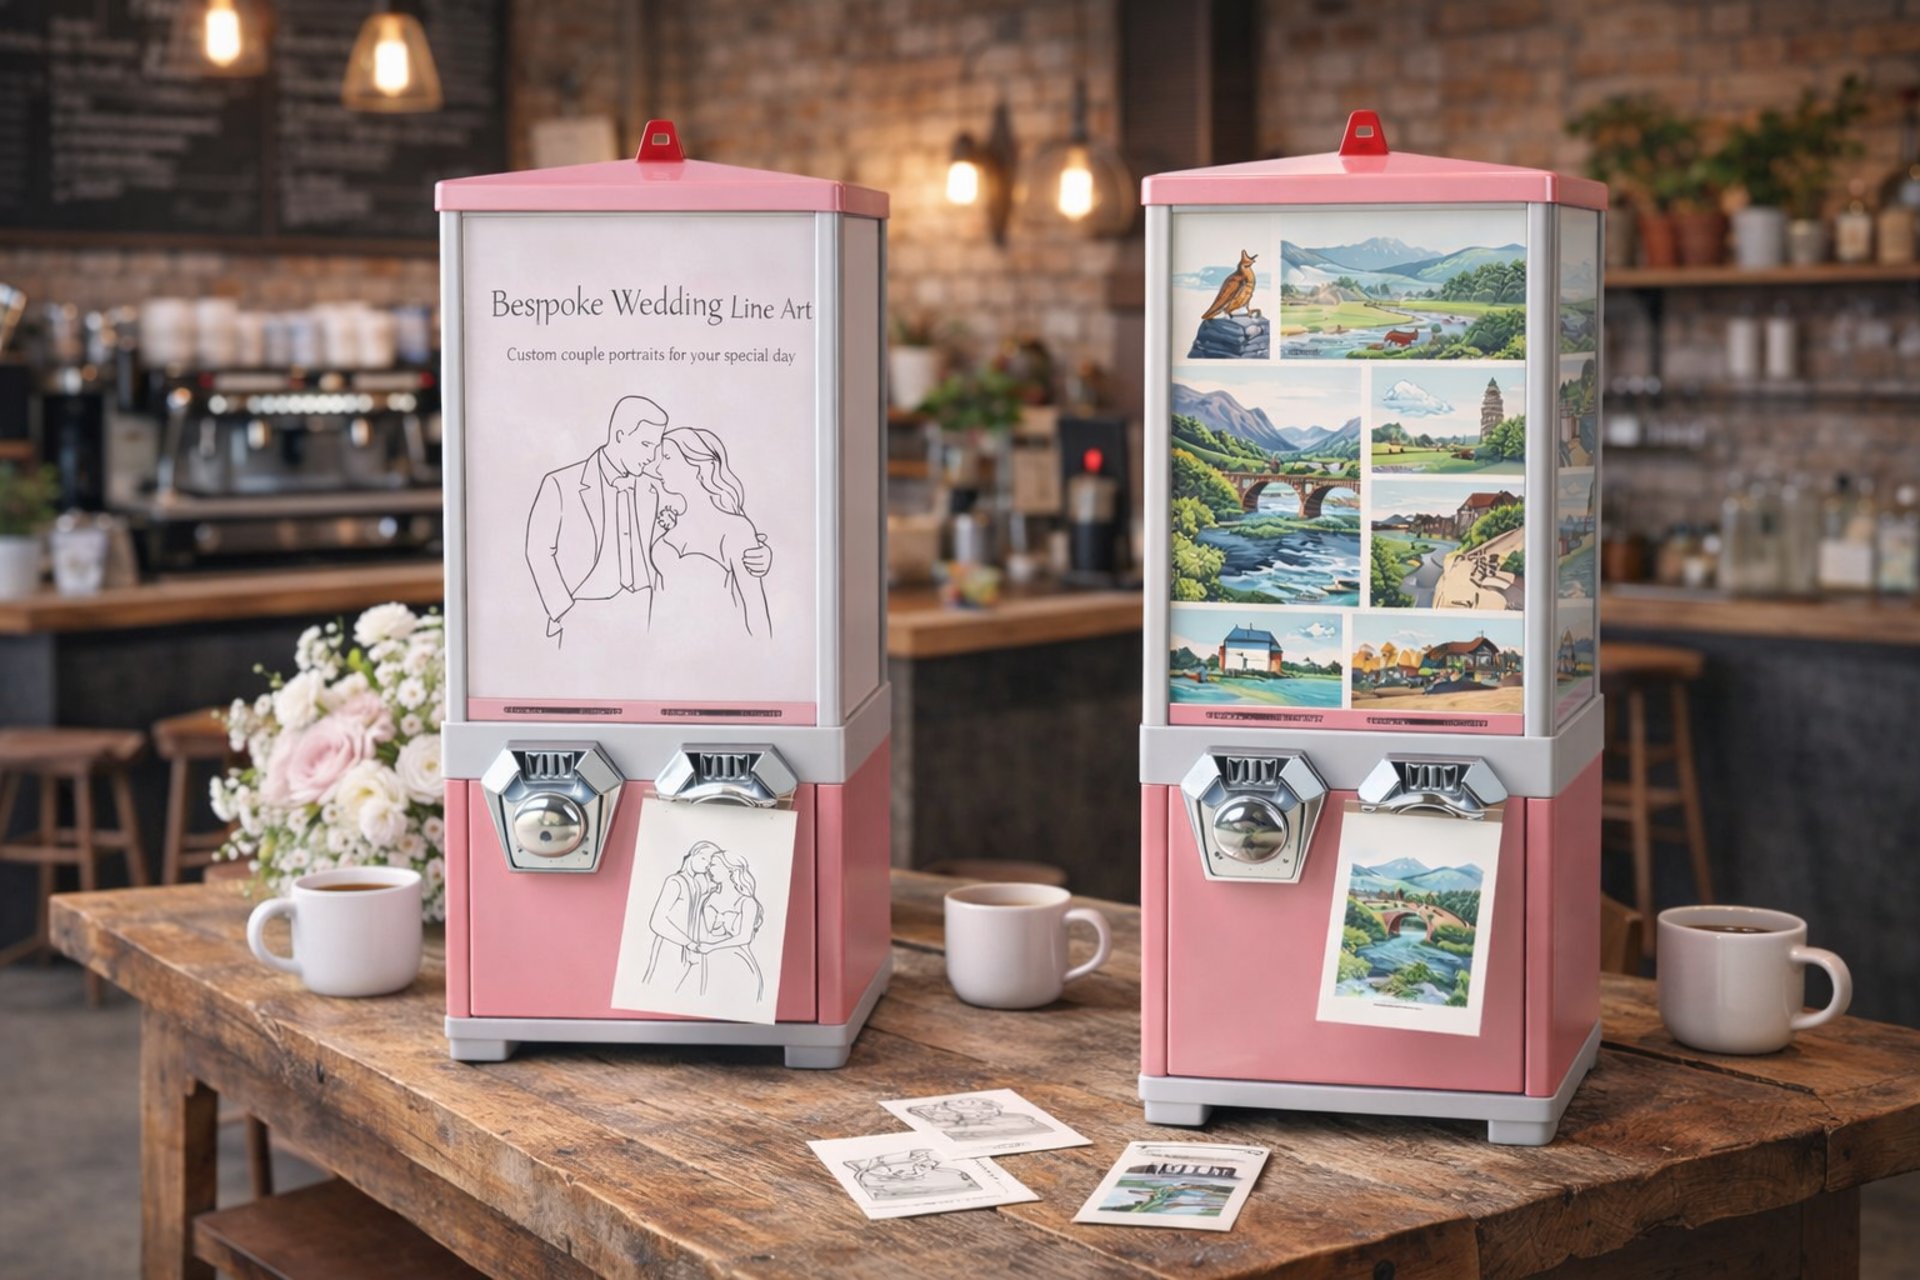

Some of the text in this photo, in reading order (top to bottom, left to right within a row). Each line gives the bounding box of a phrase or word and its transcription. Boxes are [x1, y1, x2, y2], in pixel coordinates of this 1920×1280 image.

[610, 284, 724, 327] Wedding
[730, 294, 775, 320] Line
[780, 297, 813, 320] Art
[506, 345, 796, 367] Custom couple portraits for your special day
